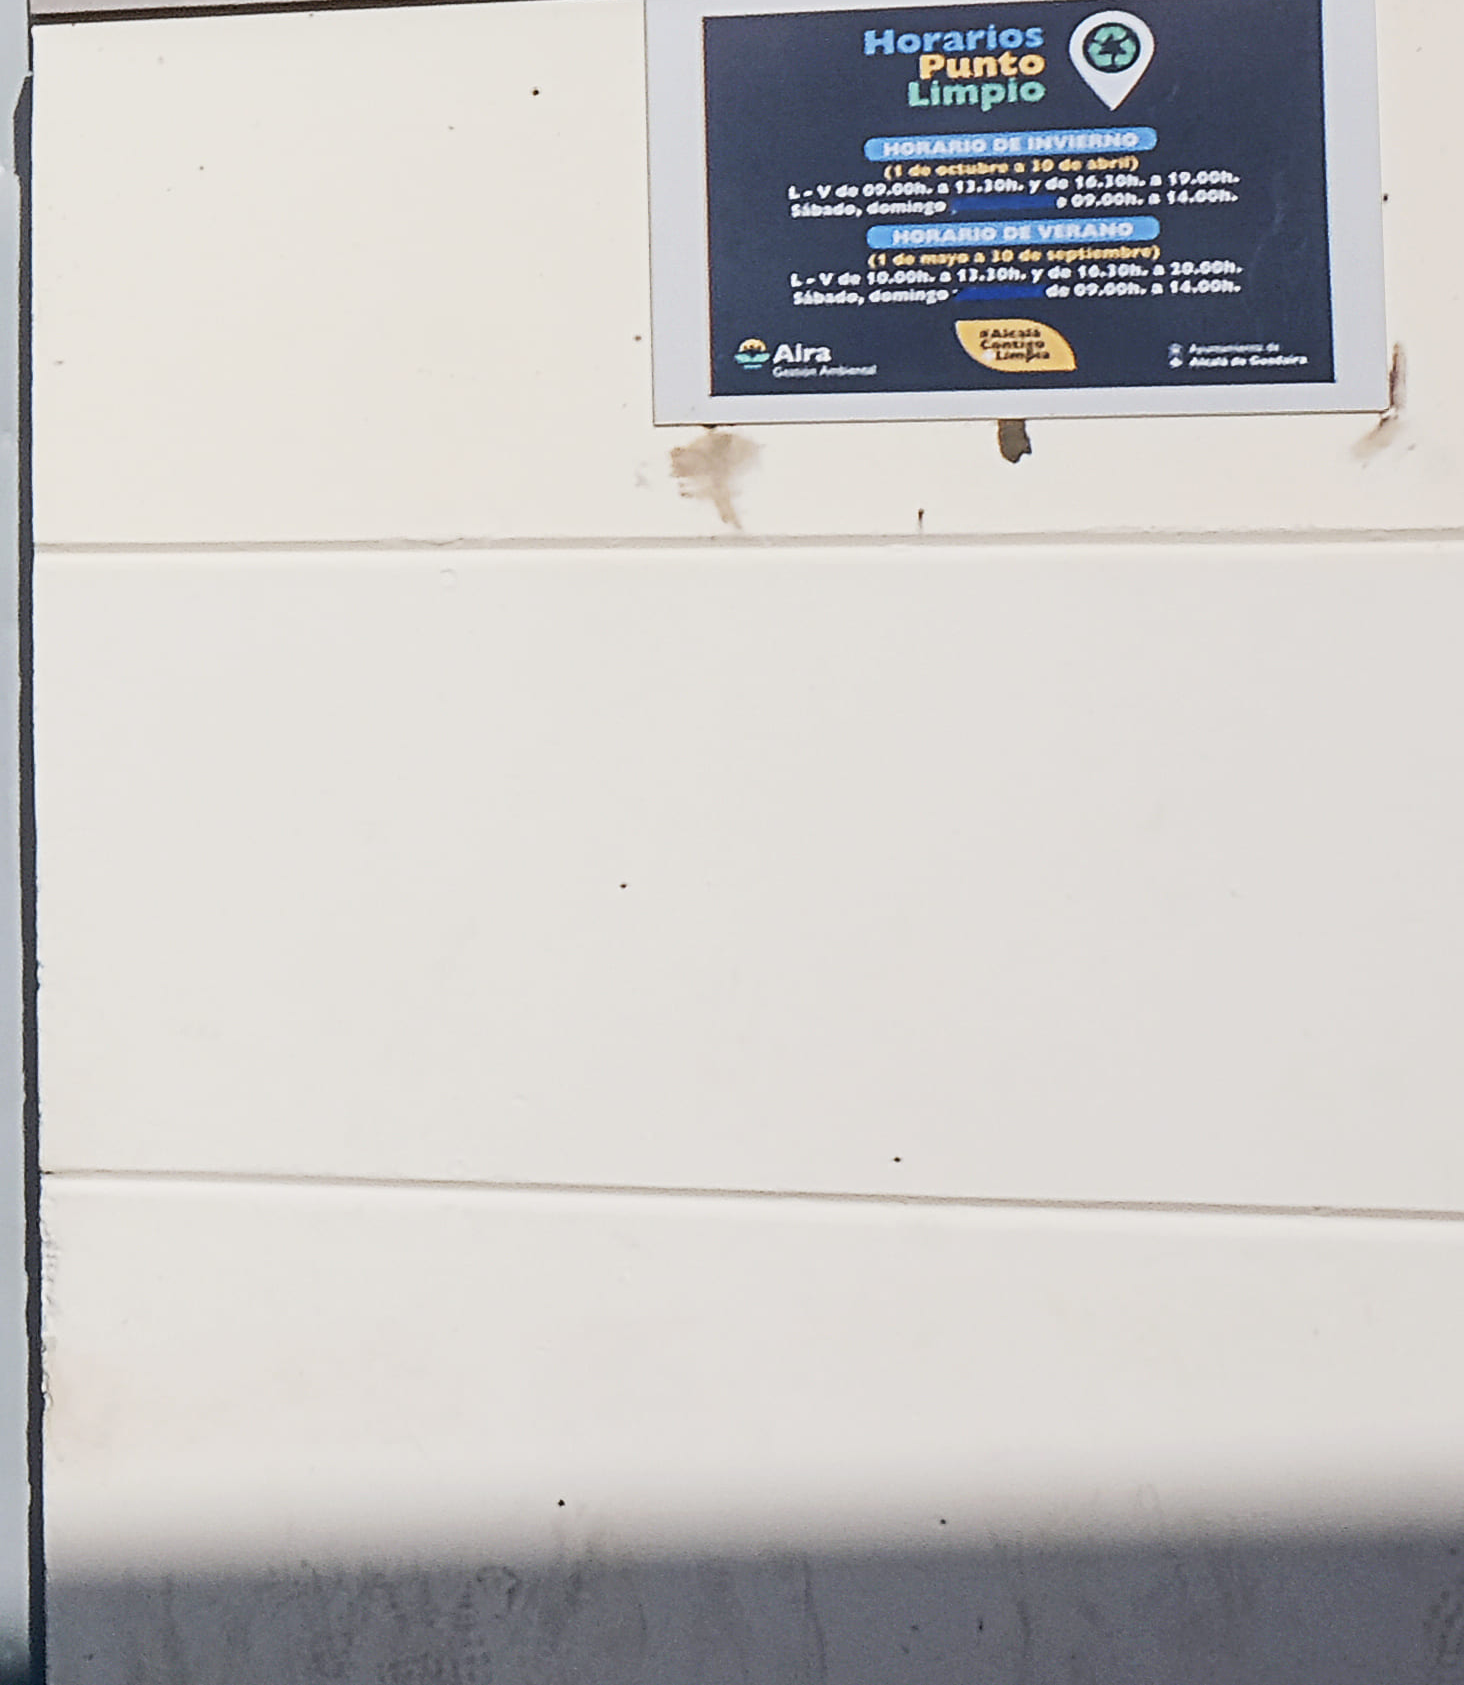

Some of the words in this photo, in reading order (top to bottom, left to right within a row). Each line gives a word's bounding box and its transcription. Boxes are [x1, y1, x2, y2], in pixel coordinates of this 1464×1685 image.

[864, 24, 1044, 55] Horarios
[919, 50, 1046, 80] Punto
[908, 77, 1046, 112] Limpio
[883, 139, 986, 156] HORARIO
[993, 136, 1021, 152] DE
[1027, 132, 1139, 150] INVIERNO
[908, 164, 931, 177] de
[935, 161, 1009, 176] octubre
[1014, 163, 1025, 173] a
[1059, 158, 1082, 171] de
[788, 185, 800, 200] L
[817, 184, 831, 199] V
[835, 184, 859, 198] de
[938, 182, 949, 194] a
[1028, 179, 1041, 195] y
[1045, 176, 1069, 190] de
[1150, 175, 1161, 186] a
[866, 199, 947, 216] domingo
[1148, 193, 1160, 205] a
[892, 227, 996, 244] HORARIO
[1003, 224, 1031, 240] DE
[1038, 222, 1134, 239] VERANO
[892, 253, 915, 266] de
[920, 253, 970, 268] mayo
[974, 252, 985, 263] a
[1018, 248, 1042, 262] de
[790, 273, 803, 288] L
[819, 272, 834, 286] V
[838, 272, 861, 285] de
[939, 271, 952, 283] a
[1031, 268, 1044, 283] y
[1047, 265, 1072, 280] de
[1153, 264, 1165, 276] a
[868, 288, 949, 305] domingo
[1045, 282, 1070, 298] de
[1151, 282, 1164, 294] a
[772, 343, 832, 364] Aira
